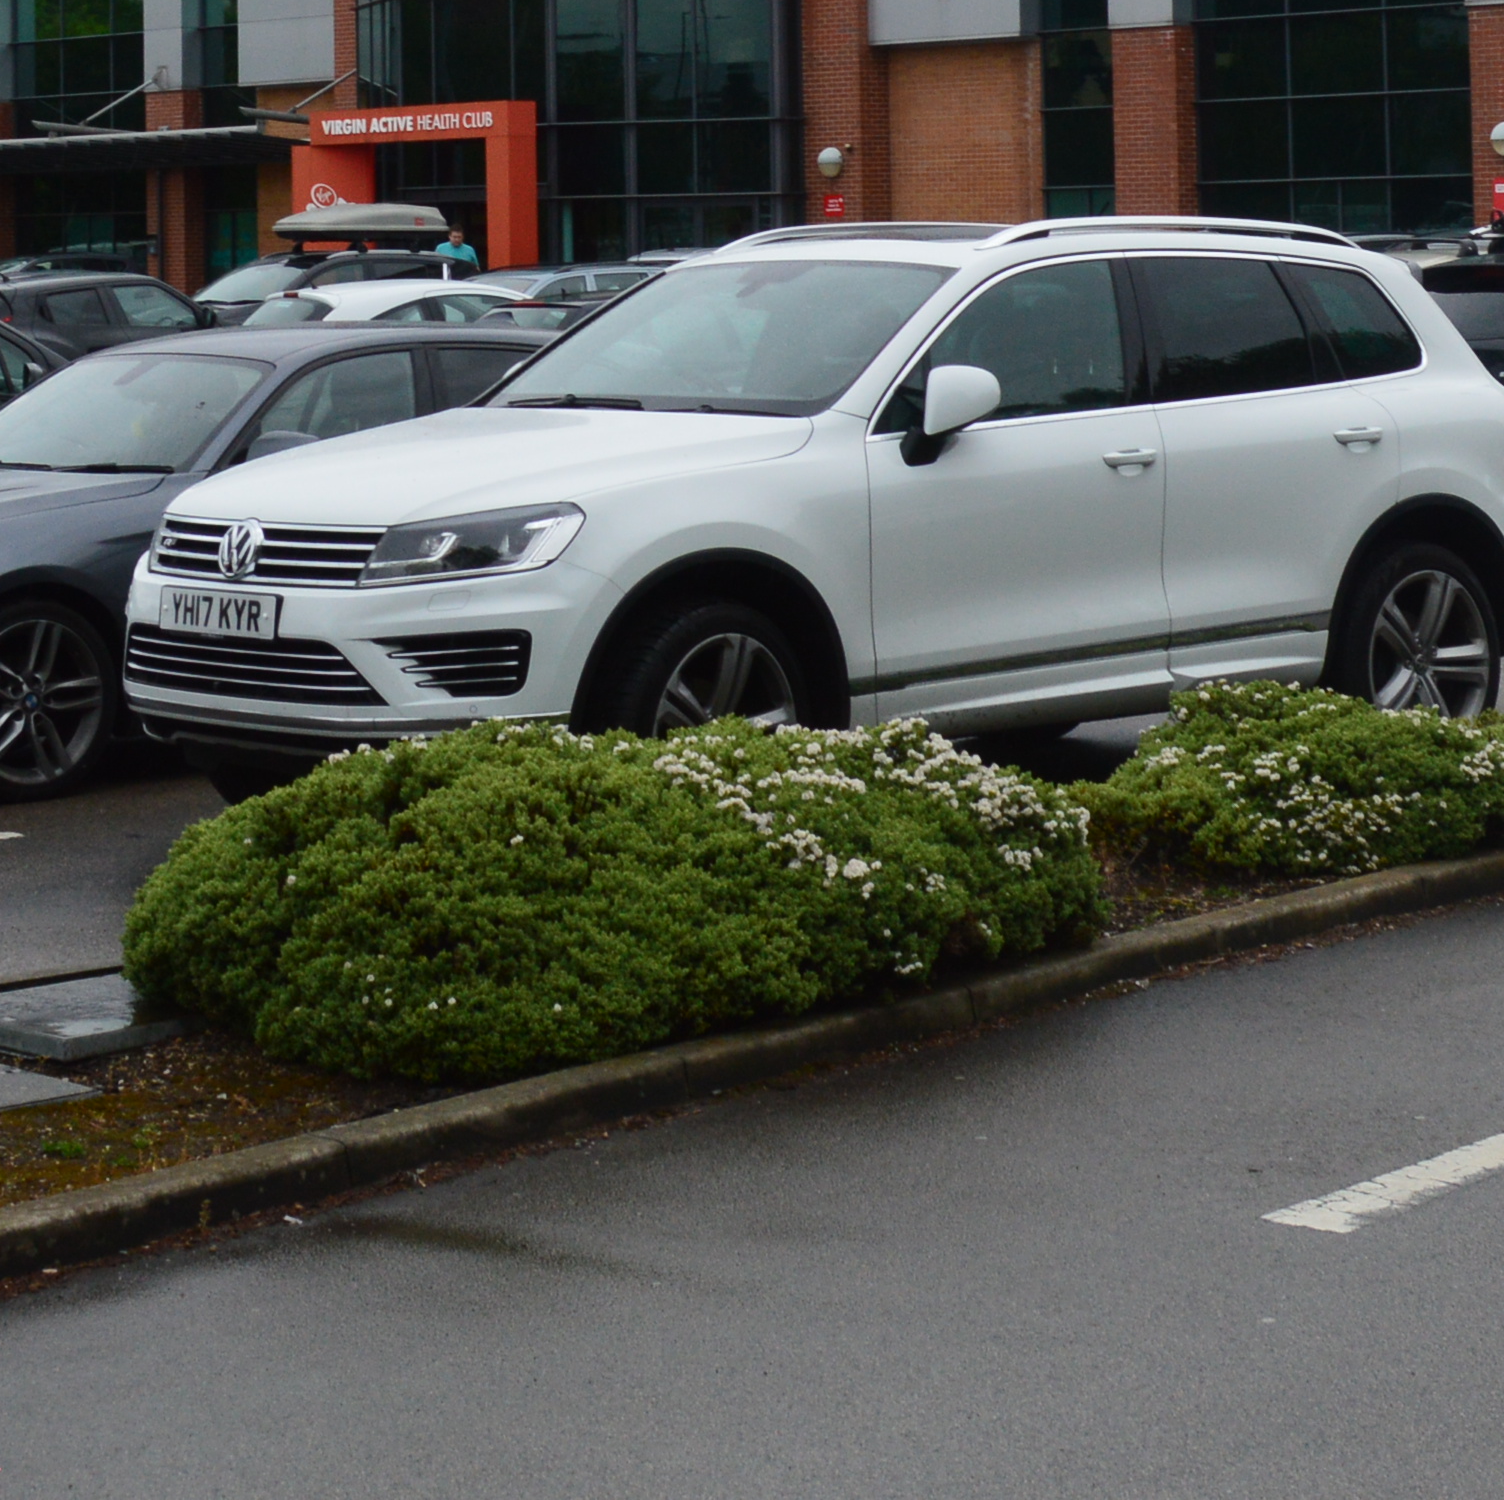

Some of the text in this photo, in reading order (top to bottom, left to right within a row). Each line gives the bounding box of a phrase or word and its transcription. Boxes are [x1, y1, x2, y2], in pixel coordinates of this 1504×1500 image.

[321, 111, 494, 135] VIRGIN ACTIVE HEALTH CLUB
[172, 593, 262, 632] YH17 KYR
